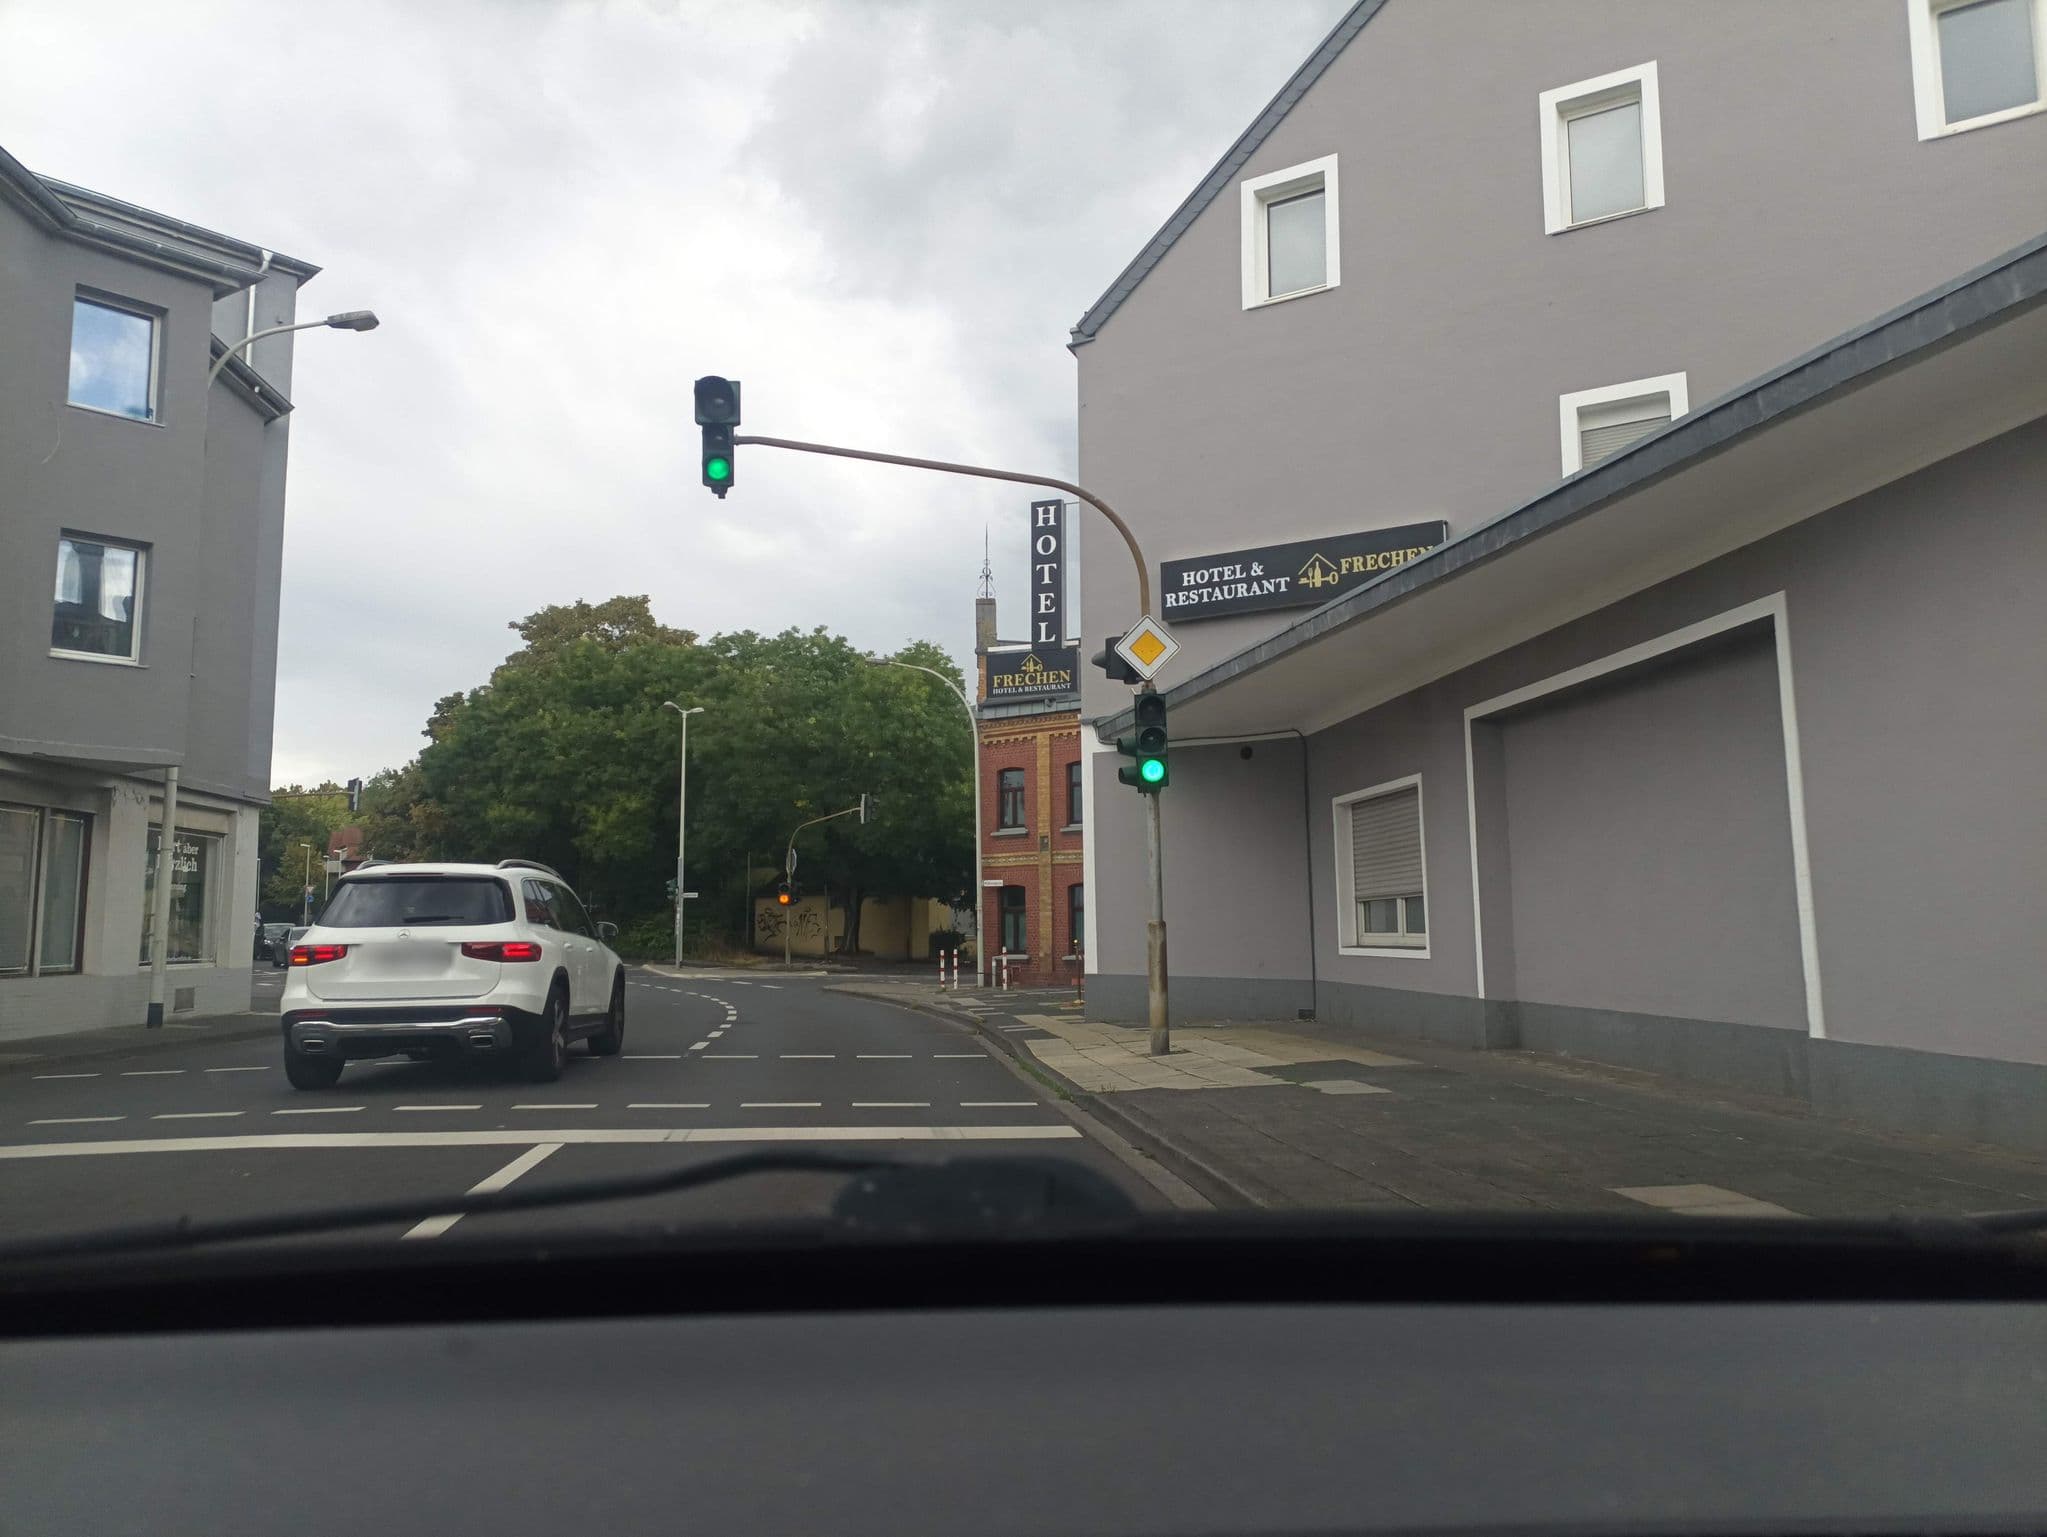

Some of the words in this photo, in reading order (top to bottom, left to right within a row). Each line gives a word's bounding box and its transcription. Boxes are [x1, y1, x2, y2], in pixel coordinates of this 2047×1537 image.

[1036, 505, 1057, 643] HOTEL
[1182, 564, 1246, 587] HOTEL
[1250, 561, 1264, 576] &
[1165, 576, 1290, 608] RESTAURANT
[992, 670, 1071, 688] FRECHEN
[993, 686, 1017, 695] HOTEL
[1025, 683, 1071, 692] RESTAURANT
